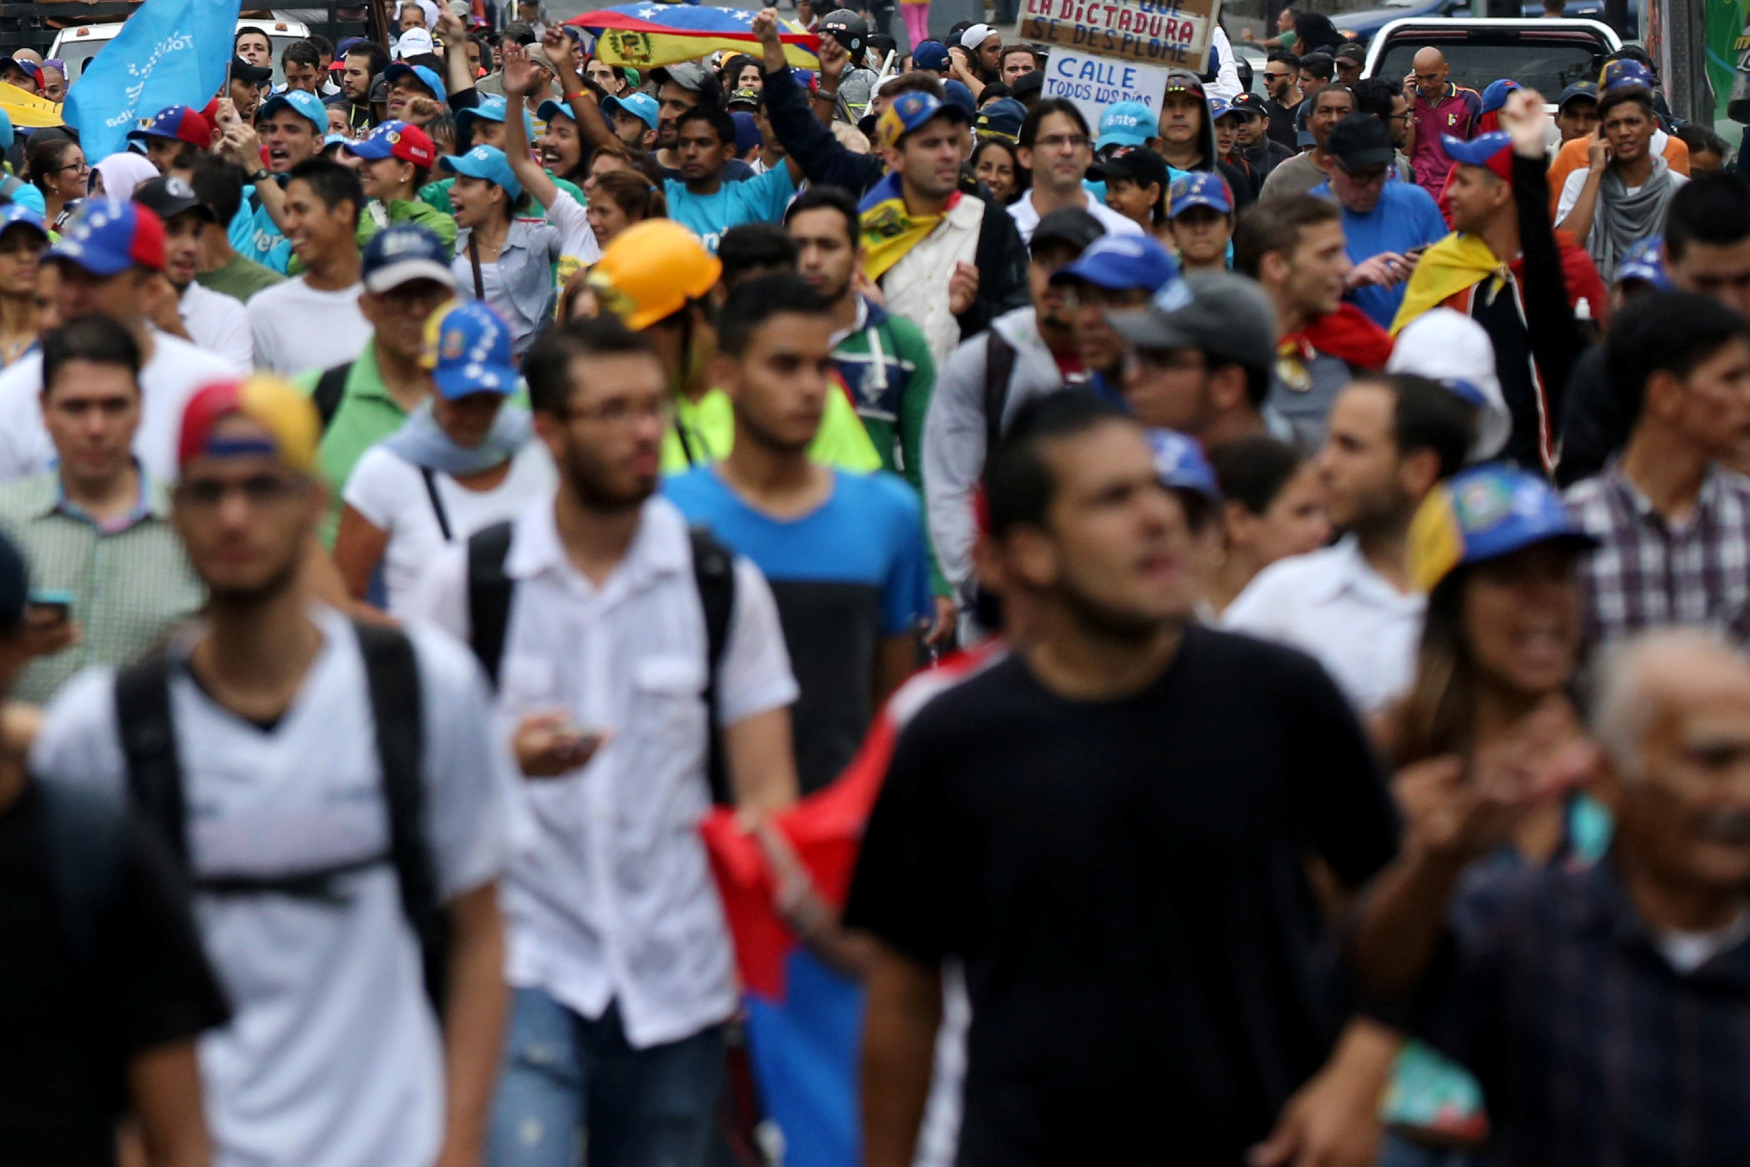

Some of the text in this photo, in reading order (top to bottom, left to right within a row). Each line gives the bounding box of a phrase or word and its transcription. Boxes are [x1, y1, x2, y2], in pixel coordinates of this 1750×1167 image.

[1030, 16, 1191, 64] SE DESPLOME
[1057, 57, 1137, 89] CALLE
[1048, 78, 1092, 101] TODOS
[1094, 87, 1119, 105] LOS
